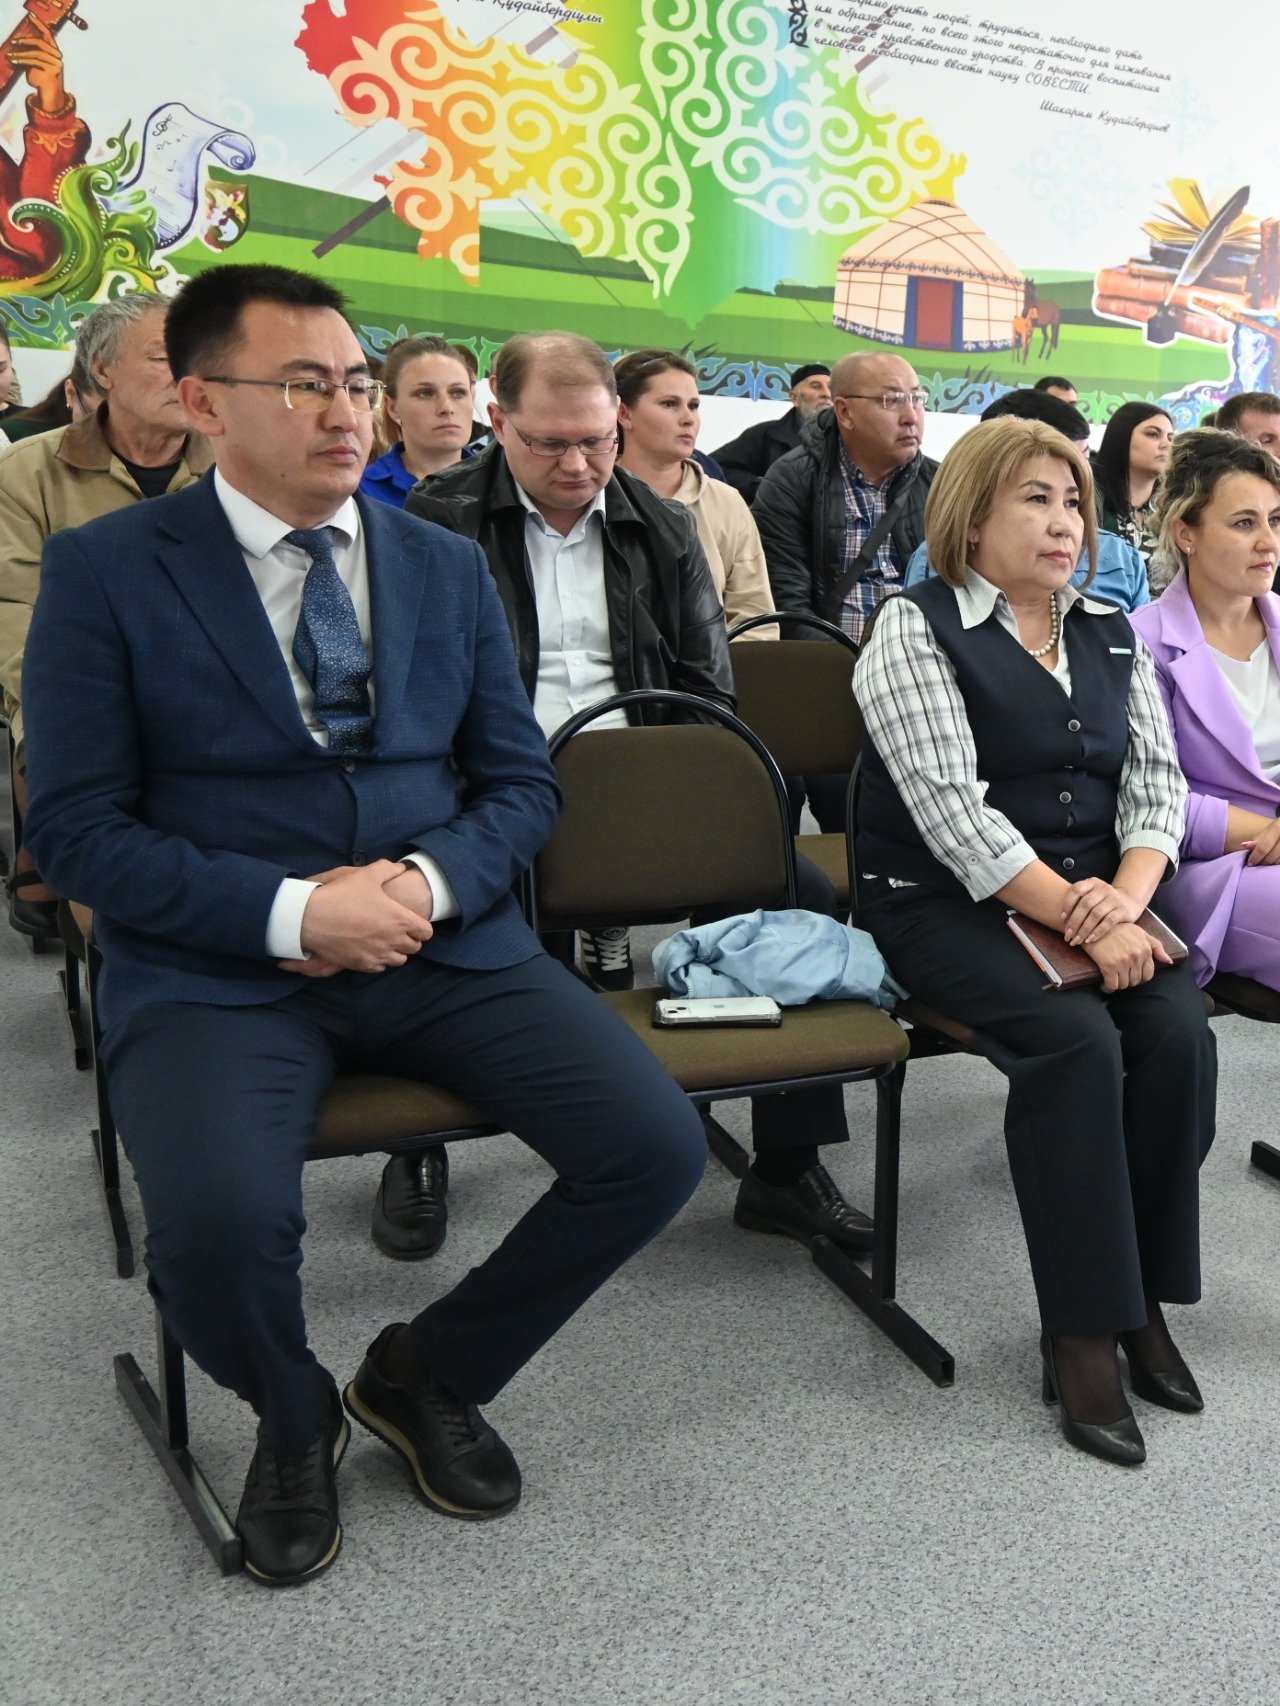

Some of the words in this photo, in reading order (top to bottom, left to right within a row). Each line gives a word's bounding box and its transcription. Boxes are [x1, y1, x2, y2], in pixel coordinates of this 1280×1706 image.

[814, 4, 832, 14] им
[837, 7, 915, 31] образование,
[921, 25, 936, 34] но
[940, 26, 968, 41] всего
[972, 34, 1004, 48] этого
[1008, 42, 1086, 64] недостаточно
[1090, 58, 1109, 69] для
[1113, 63, 1172, 81] изживания
[814, 17, 823, 28] в
[826, 23, 877, 39] человеке
[880, 31, 968, 56] нравственного
[971, 49, 1028, 68] уродства.
[1033, 58, 1045, 71] В
[1047, 64, 1093, 80] процессе
[1096, 72, 1161, 93] воспитания
[892, 4, 928, 17] учить
[932, 12, 972, 27] людей,
[978, 19, 1044, 41] трудиться,
[1049, 35, 1111, 54] необходимо
[1115, 48, 1143, 61] дать
[814, 35, 866, 53] человека
[871, 47, 939, 66] необходимо
[987, 68, 1020, 84] науку
[1025, 71, 1091, 95] СОВЕСТИ.
[1039, 99, 1093, 119] Шакарим
[1097, 110, 1171, 133] Кудайбердиев
